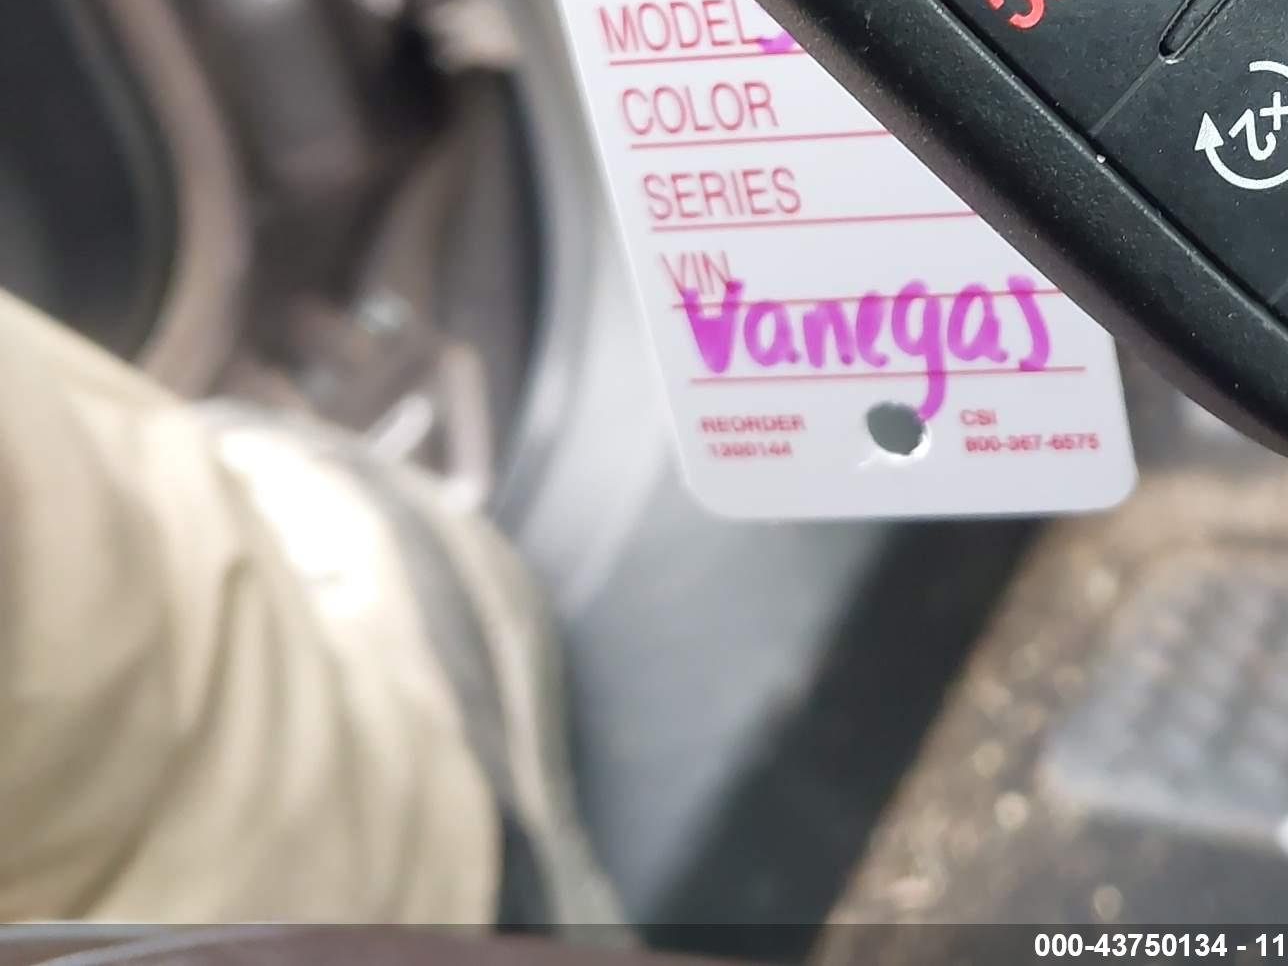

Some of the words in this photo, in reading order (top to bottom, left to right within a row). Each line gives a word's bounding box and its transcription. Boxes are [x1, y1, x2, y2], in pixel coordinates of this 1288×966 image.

[622, 82, 779, 137] COLOR
[643, 167, 802, 221] SERIES
[659, 250, 733, 296] VIN
[700, 413, 806, 434] REORDER
[960, 409, 997, 426] CSI
